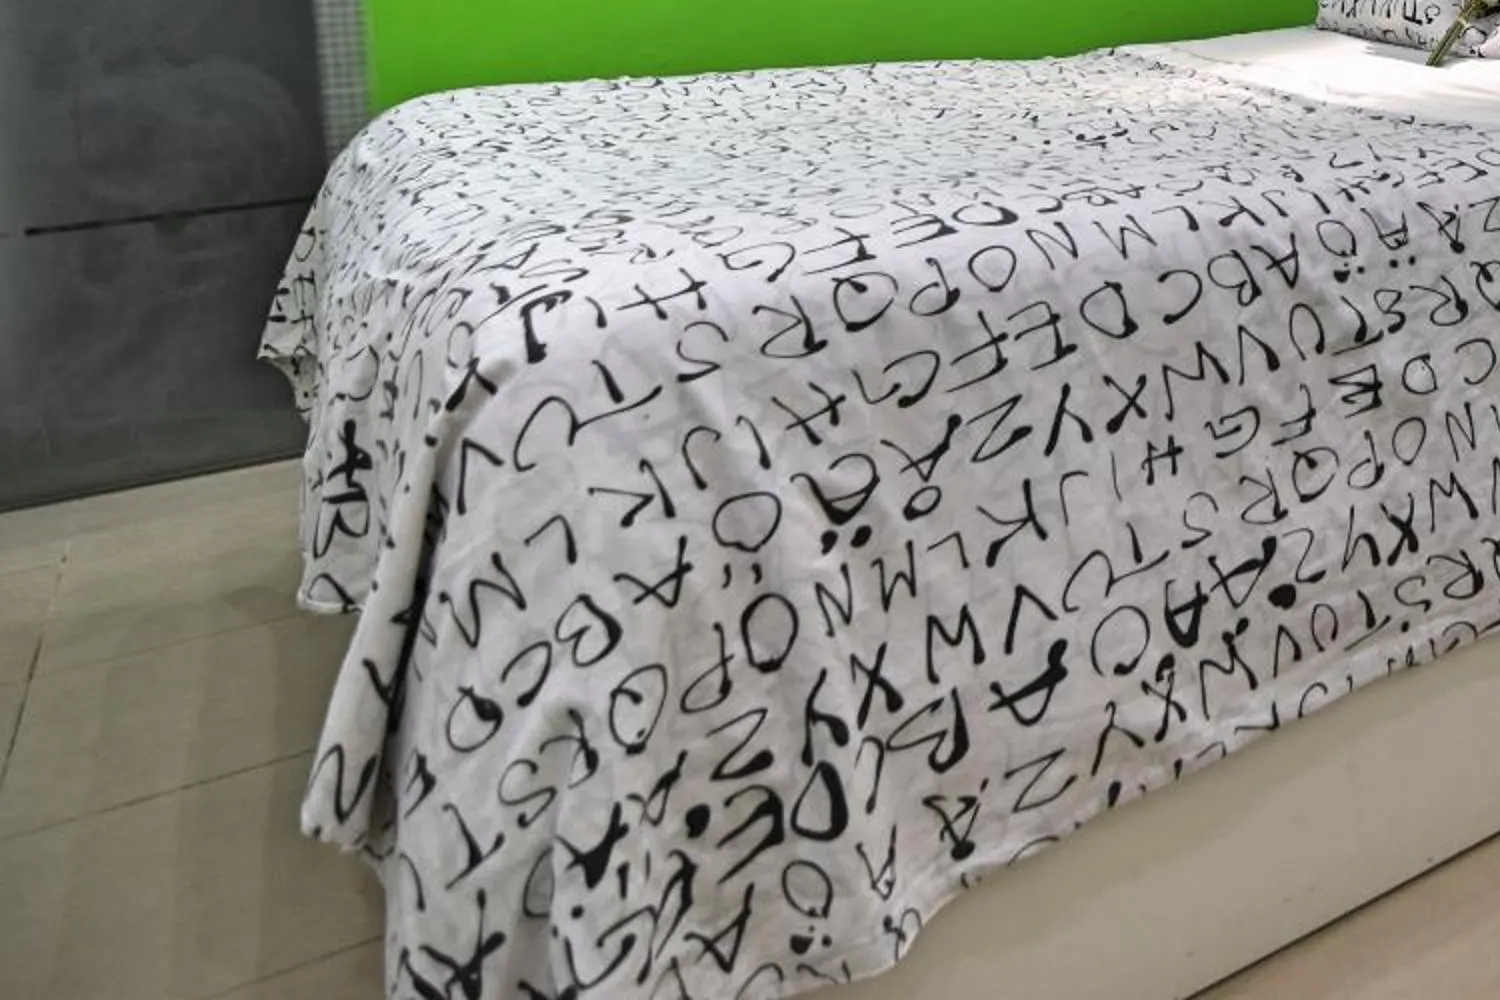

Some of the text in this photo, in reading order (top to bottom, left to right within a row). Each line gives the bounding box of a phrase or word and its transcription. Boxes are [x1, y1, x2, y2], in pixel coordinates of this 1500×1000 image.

[1156, 268, 1204, 327] C
[1205, 247, 1264, 309] B
[1248, 231, 1301, 292] A
[1078, 279, 1140, 341] D
[1407, 273, 1470, 328] R
[945, 310, 1008, 393] F
[1160, 339, 1232, 424] W
[1236, 323, 1282, 387] V
[1453, 336, 1498, 387] C
[964, 393, 1034, 471] Z
[1042, 381, 1095, 458] Y
[1101, 372, 1149, 436] X
[1270, 382, 1318, 448] F
[1140, 433, 1186, 487] H
[1237, 467, 1290, 526] R
[1290, 445, 1341, 505] Q
[975, 476, 1050, 570] K
[1428, 470, 1481, 535] W
[611, 534, 695, 610] A
[813, 561, 854, 639] N
[1424, 548, 1486, 602] R
[553, 592, 625, 669] B
[738, 590, 801, 676] O
[924, 602, 987, 686] W
[1002, 582, 1060, 657] V
[499, 639, 554, 710] C
[678, 621, 735, 716] P
[986, 637, 1070, 729] A
[607, 662, 669, 758] Q
[705, 706, 776, 783] Z
[885, 686, 970, 774] B
[1002, 746, 1079, 815] Z
[684, 883, 754, 975] A
